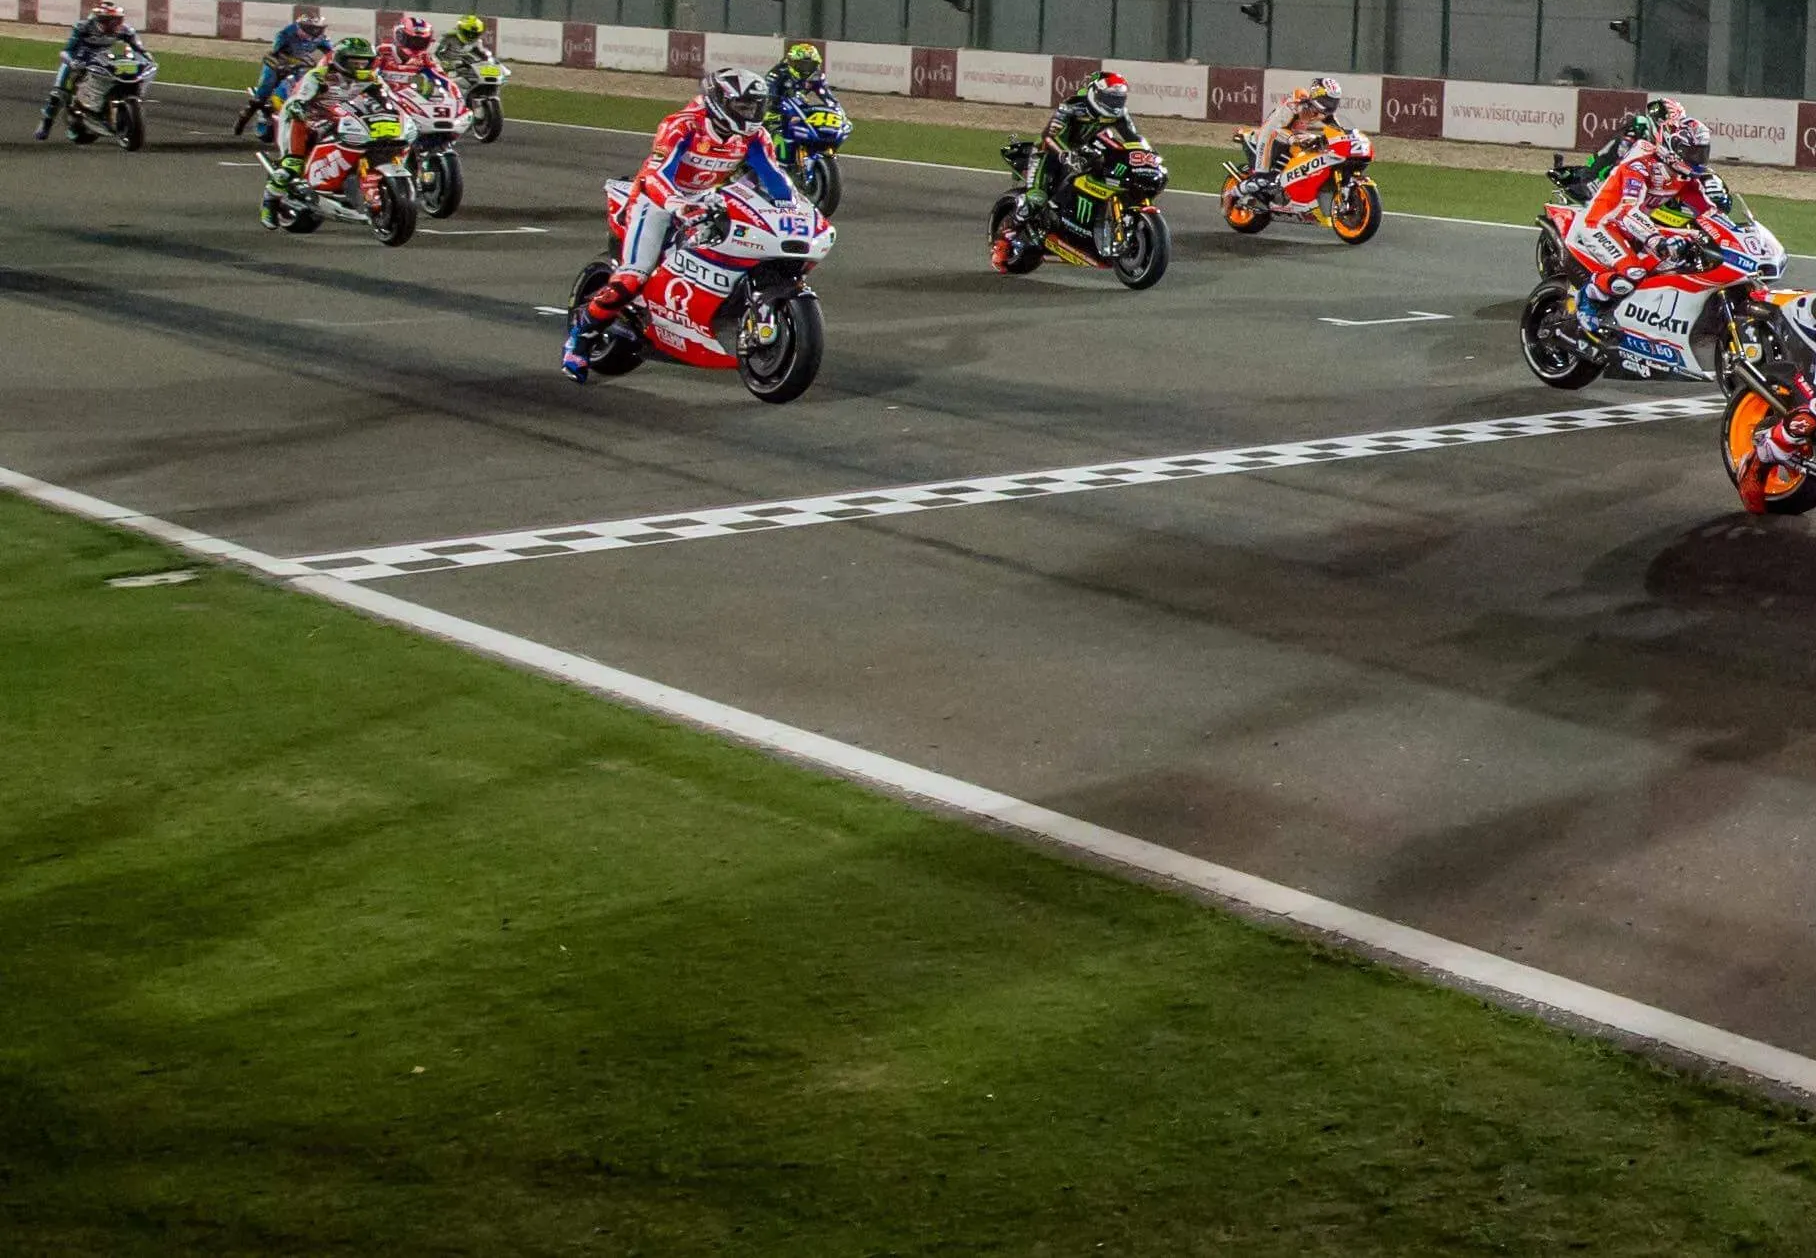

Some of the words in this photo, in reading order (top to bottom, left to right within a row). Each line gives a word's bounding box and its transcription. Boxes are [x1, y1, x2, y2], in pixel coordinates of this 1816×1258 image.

[1211, 82, 1258, 110] QATAR
[1386, 95, 1439, 123] QATAR
[805, 111, 843, 128] 46
[1592, 230, 1623, 260] DUCATI
[1737, 256, 1757, 271] TIM
[1624, 302, 1690, 336] DUCATI
